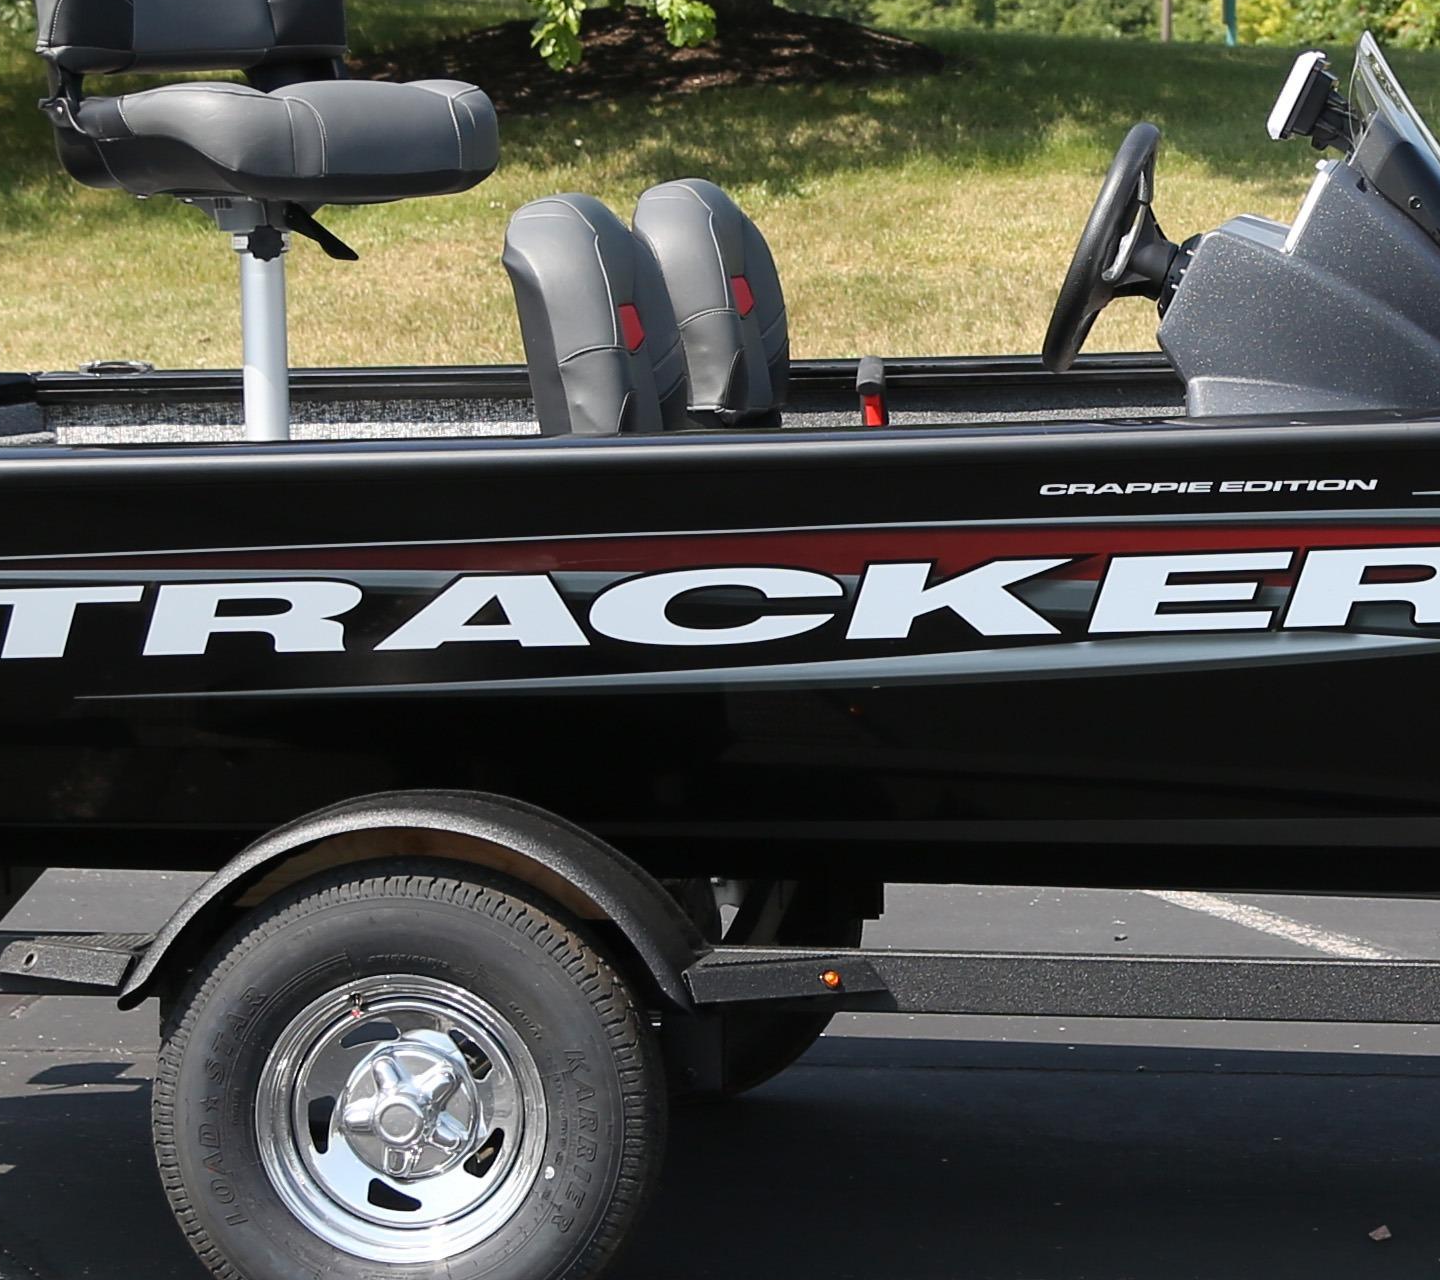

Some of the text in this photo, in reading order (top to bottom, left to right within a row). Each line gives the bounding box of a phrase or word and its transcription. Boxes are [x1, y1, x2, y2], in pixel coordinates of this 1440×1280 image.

[1039, 479, 1378, 496] CRAPPIE EDITION
[550, 1048, 599, 1234] KARRIER
